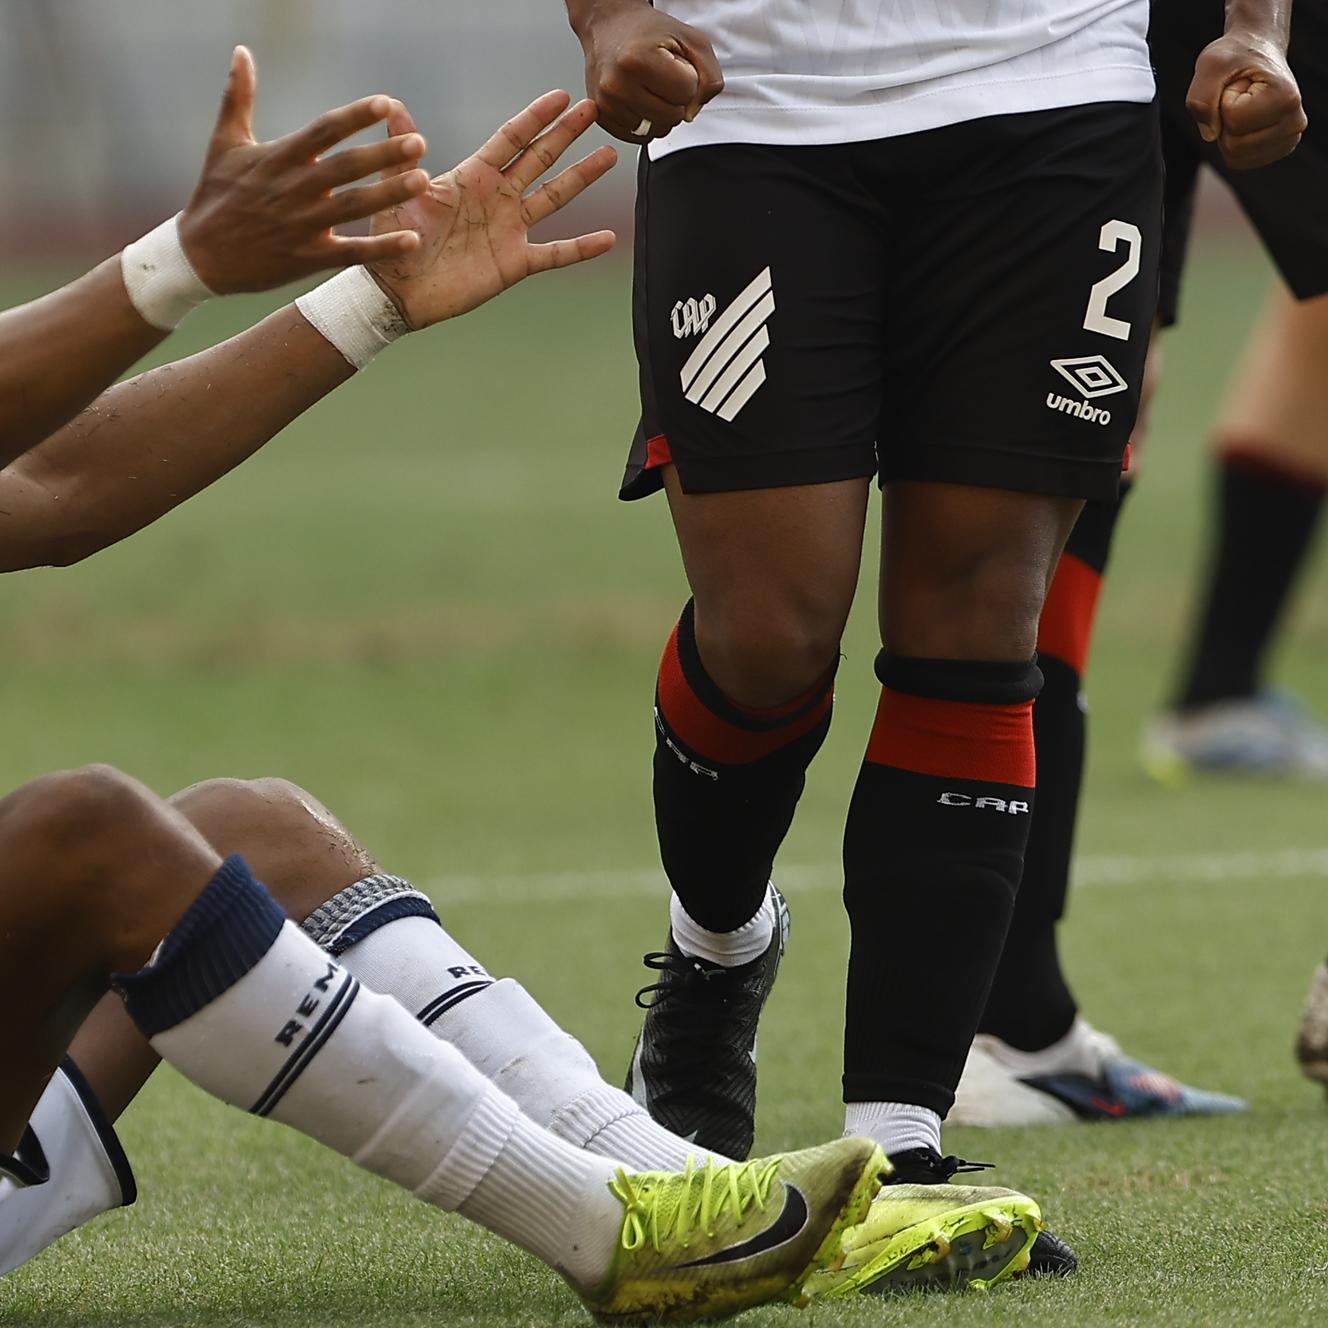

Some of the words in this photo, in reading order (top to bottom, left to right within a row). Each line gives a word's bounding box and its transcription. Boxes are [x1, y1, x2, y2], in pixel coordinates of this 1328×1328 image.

[1082, 219, 1142, 341] 2
[1046, 392, 1111, 426] umbro
[275, 962, 339, 1047] REM
